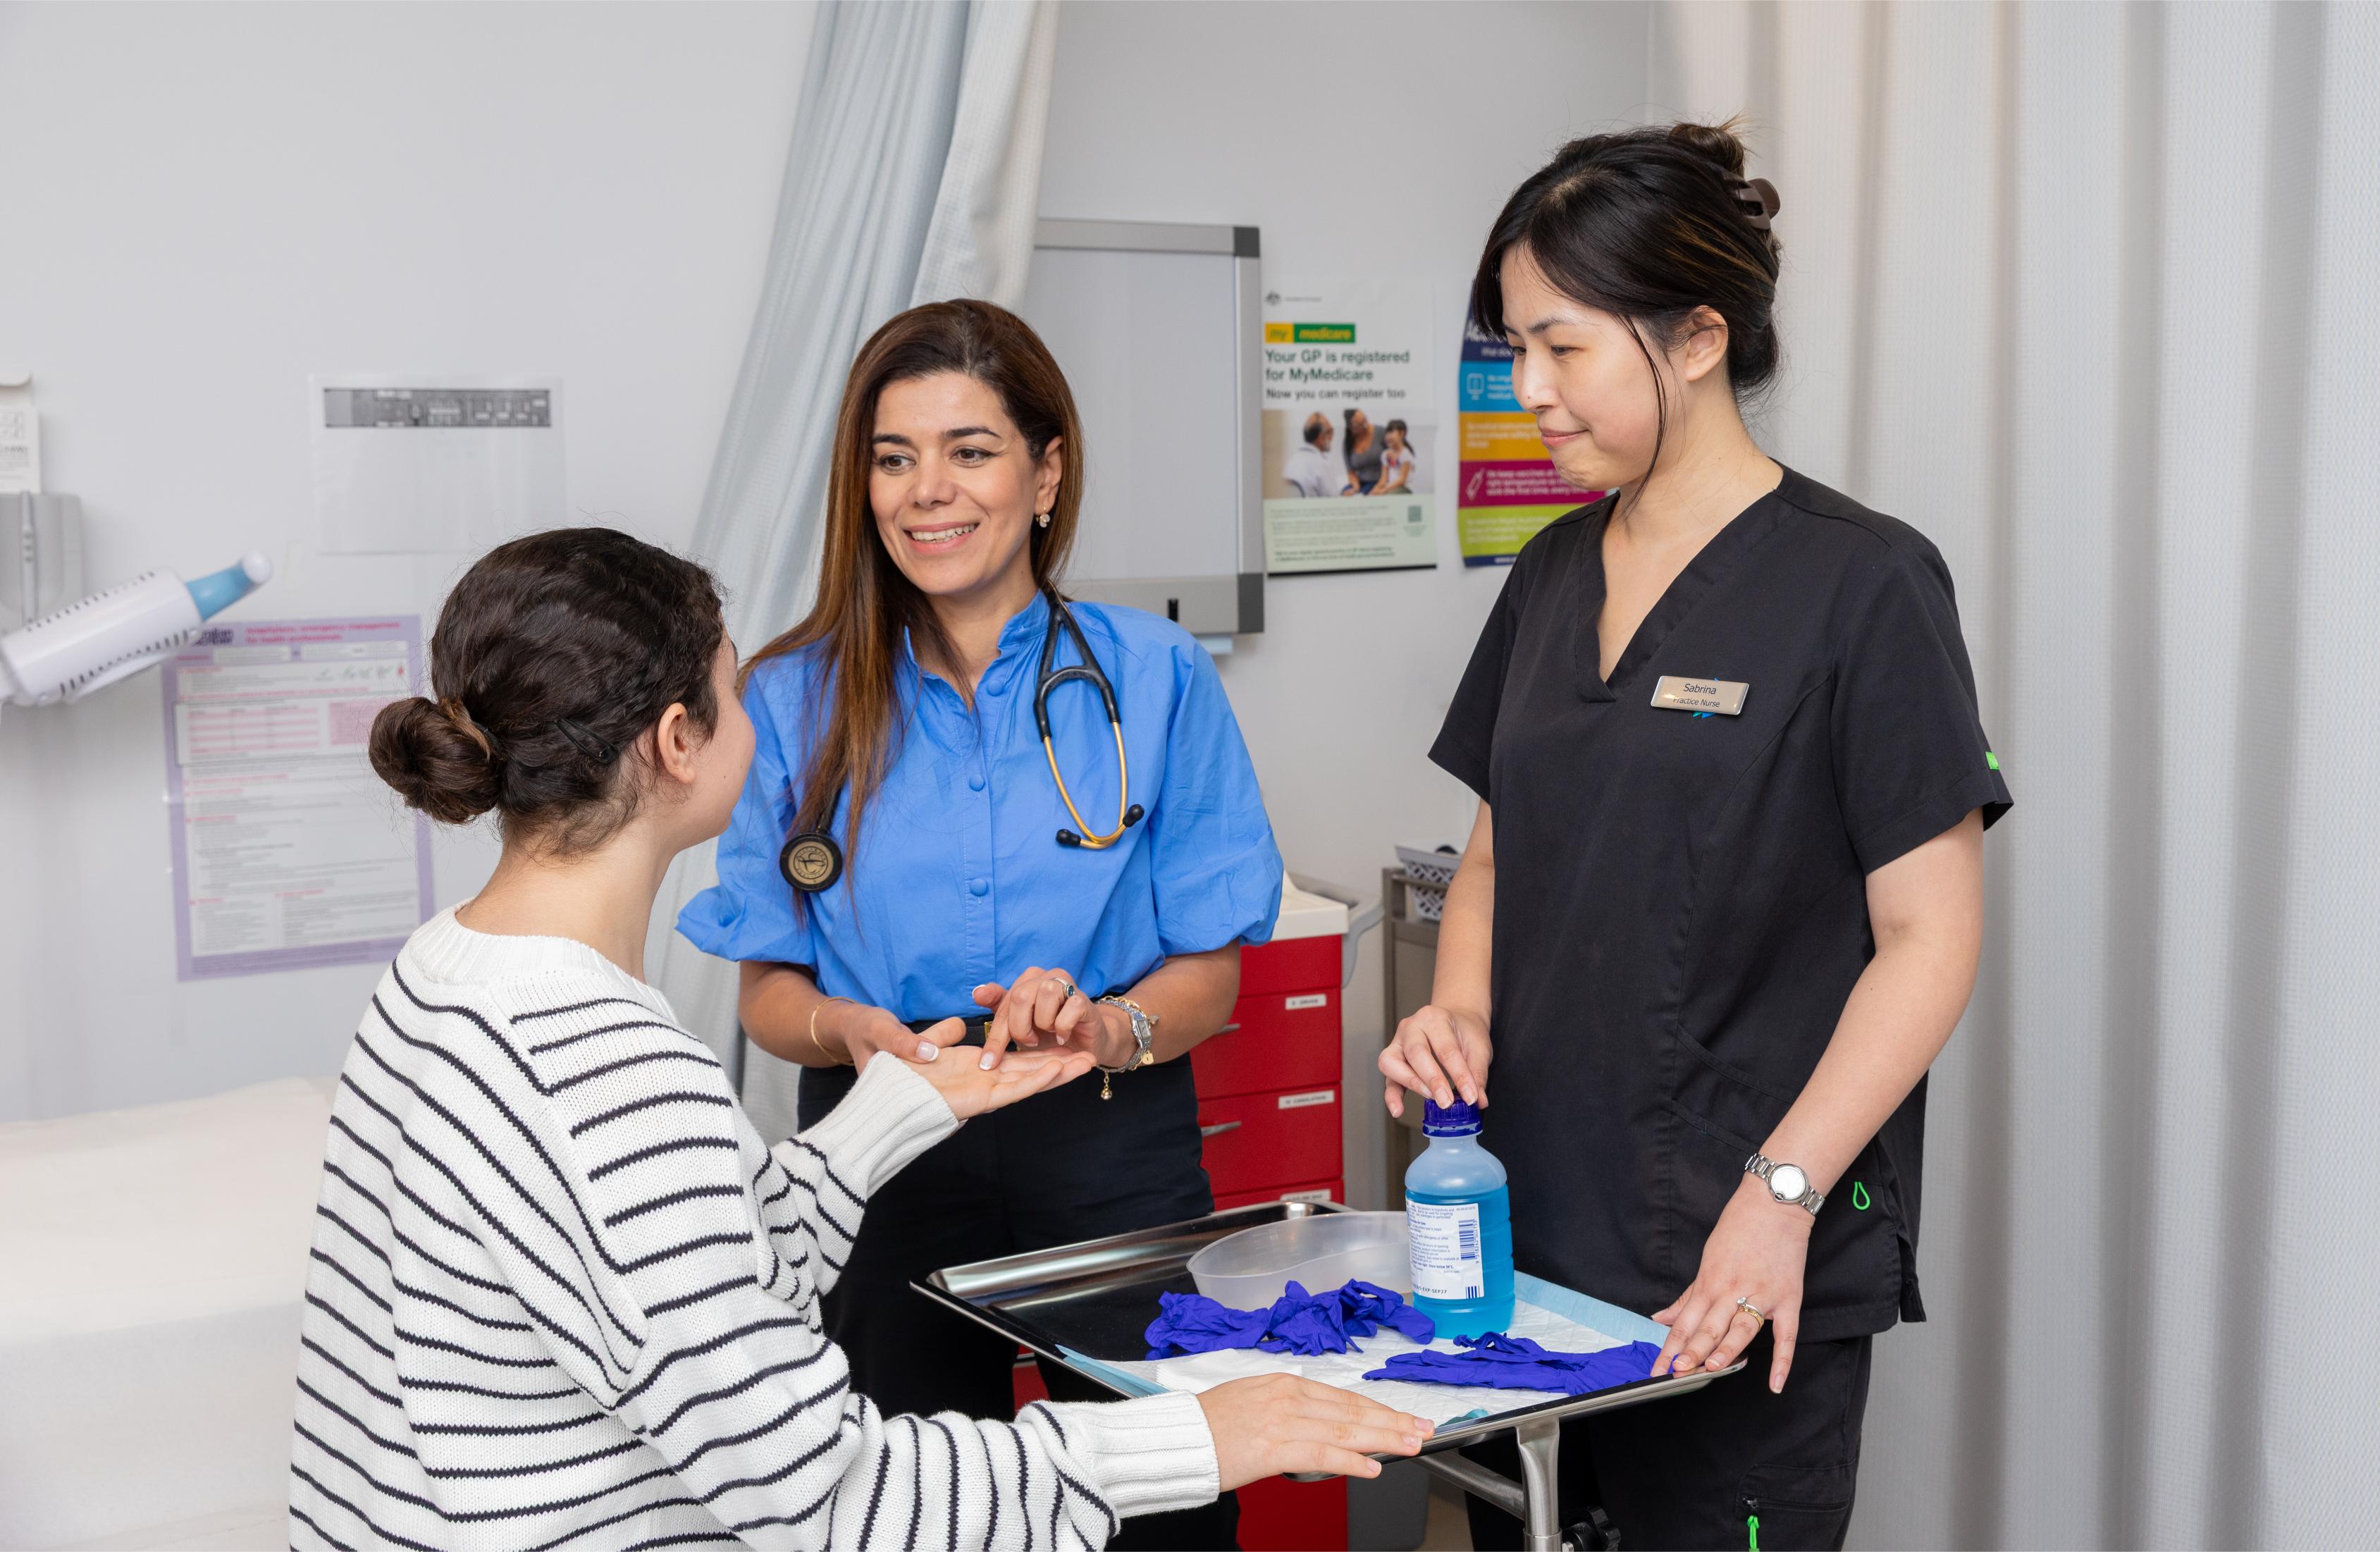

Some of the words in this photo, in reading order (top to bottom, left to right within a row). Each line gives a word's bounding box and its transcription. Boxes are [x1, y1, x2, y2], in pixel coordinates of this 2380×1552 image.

[1269, 329, 1288, 341] my
[1299, 326, 1352, 340] medicare
[1266, 350, 1295, 362] Your
[1301, 350, 1321, 362] GP
[1326, 350, 1337, 362] is
[1341, 350, 1410, 365] registered
[1266, 368, 1284, 381] for
[1289, 368, 1373, 383] MyMedicare
[1266, 389, 1290, 399] Now
[1295, 390, 1314, 401] you
[1318, 390, 1338, 399] can
[1342, 388, 1383, 400] register
[1387, 388, 1406, 398] too
[1517, 468, 1545, 477] vaccines
[1683, 683, 1717, 695] Sabrina
[1701, 698, 1720, 708] Nurse
